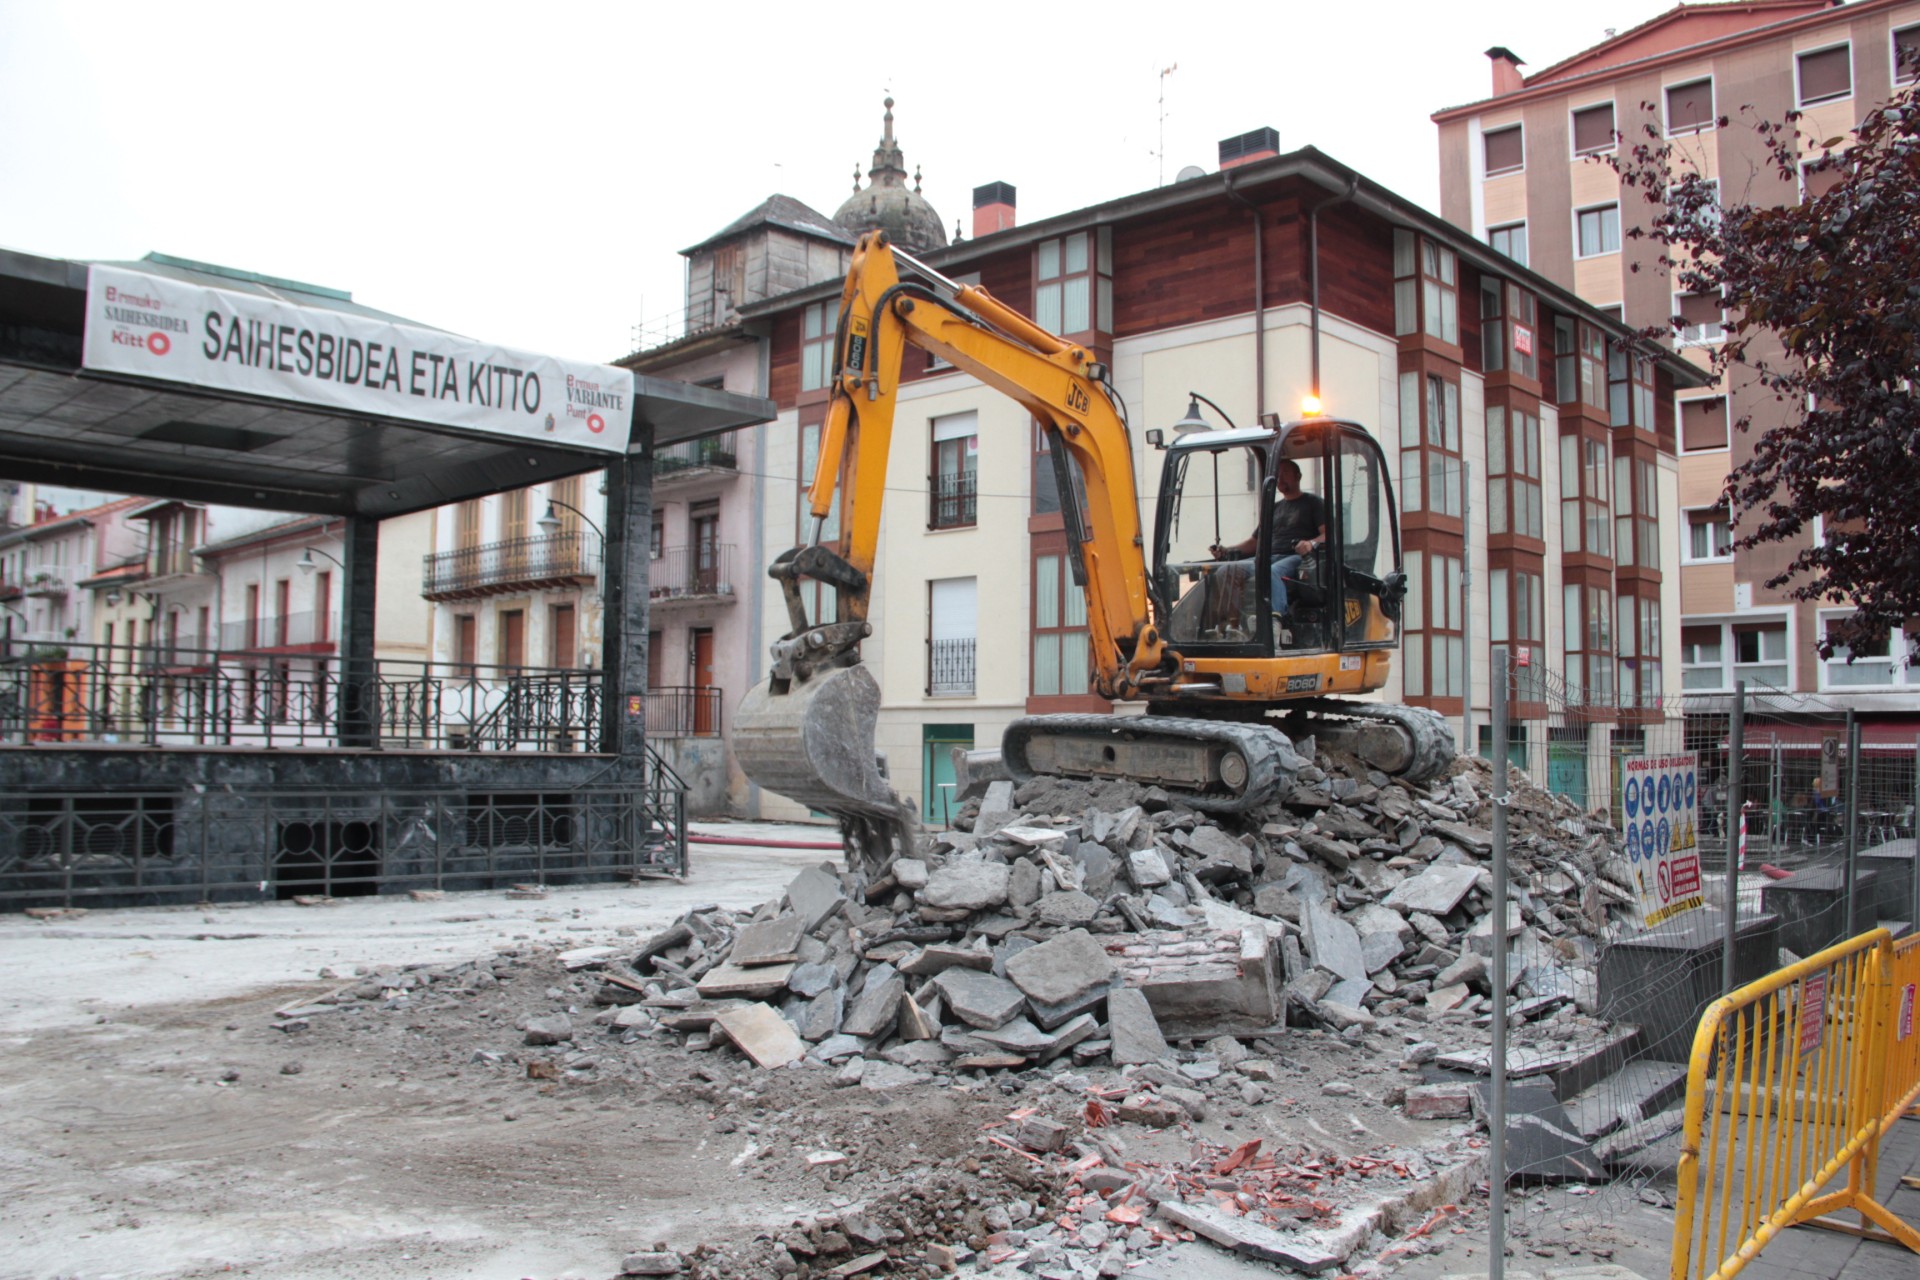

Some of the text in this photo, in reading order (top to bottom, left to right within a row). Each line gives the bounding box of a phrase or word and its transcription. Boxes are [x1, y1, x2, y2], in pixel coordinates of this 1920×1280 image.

[104, 305, 189, 334] SAIHESBIDEA
[202, 310, 541, 414] SAIHESBIDEA ETA KITTO
[566, 386, 624, 411] VARIANTE
[1067, 382, 1089, 413] JCB
[1627, 760, 1649, 771] NORMAS
[1650, 759, 1657, 769] DE
